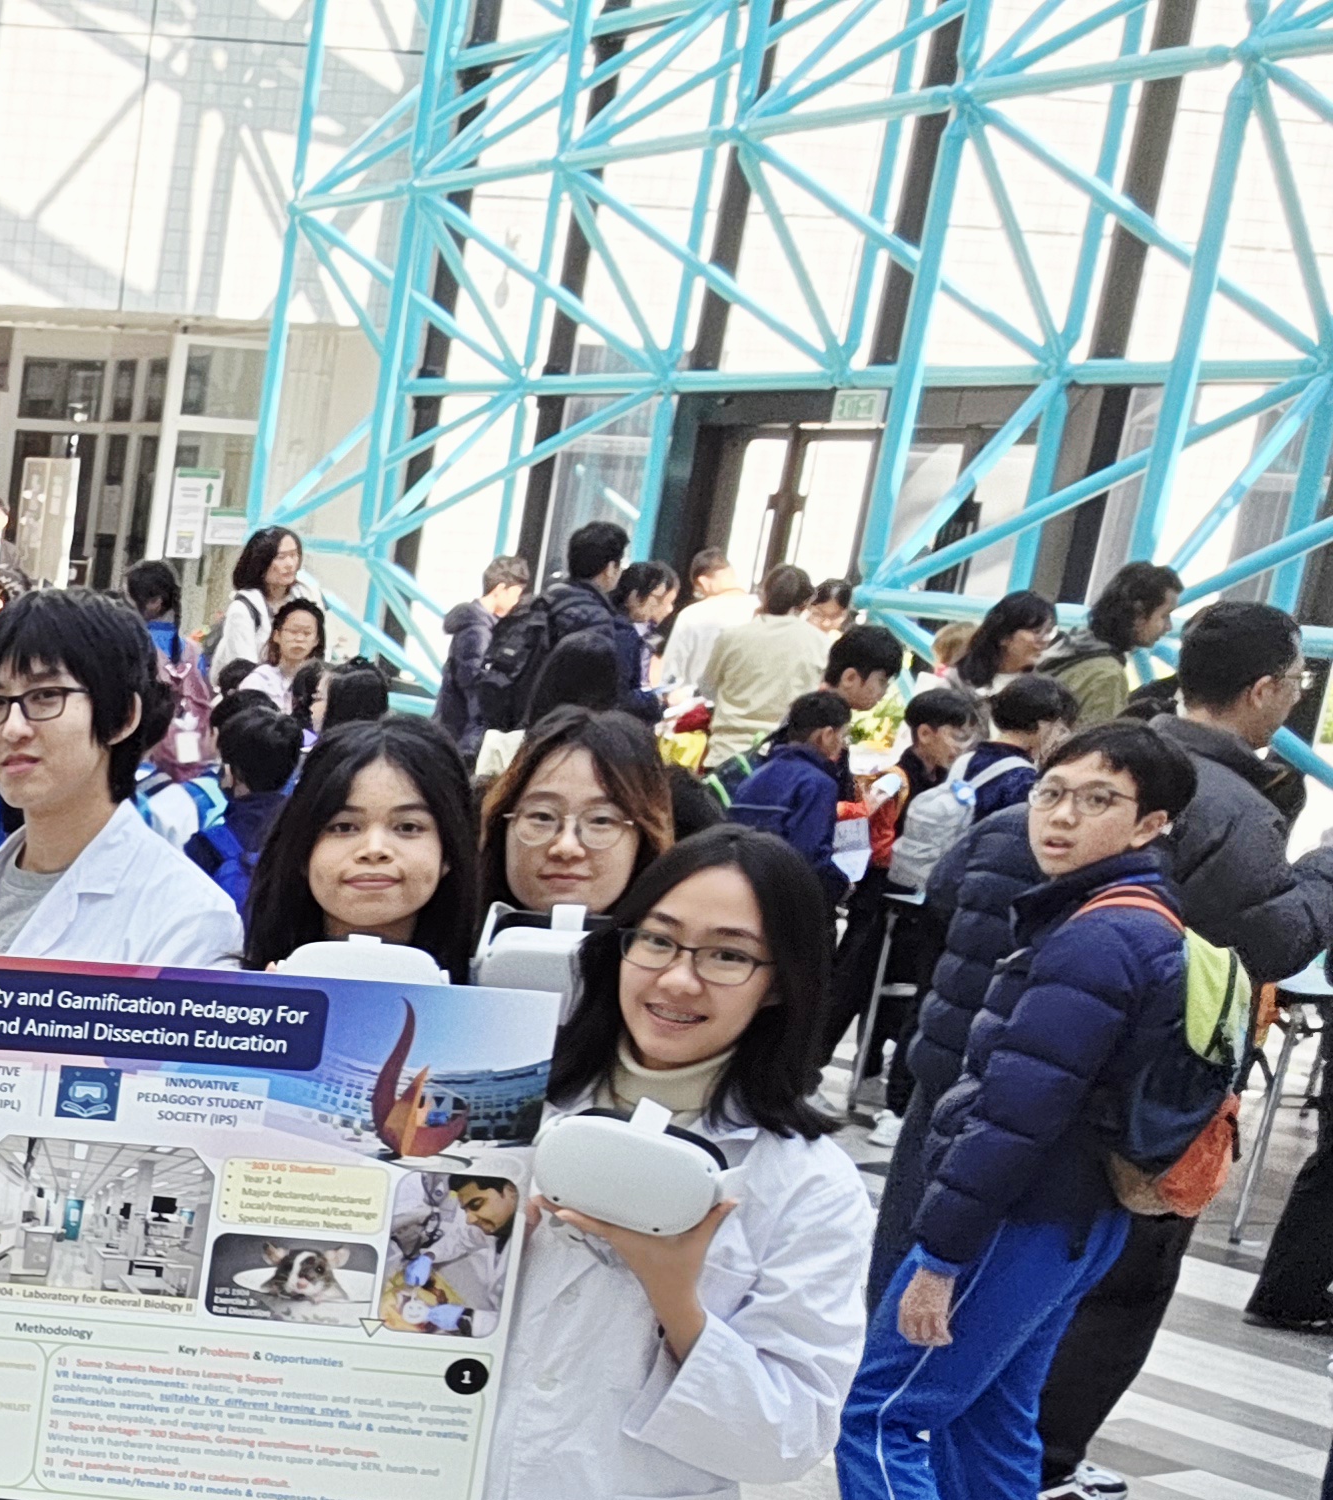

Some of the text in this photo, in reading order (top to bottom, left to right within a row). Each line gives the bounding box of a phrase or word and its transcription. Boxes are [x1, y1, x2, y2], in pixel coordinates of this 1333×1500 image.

[16, 989, 53, 1007] and
[57, 990, 175, 1015] Gamification
[180, 998, 272, 1025] Pedagogy
[275, 1005, 308, 1024] For
[23, 1018, 89, 1039] Animal
[93, 1022, 188, 1046] Dissection
[193, 1029, 287, 1053] Education
[165, 1076, 239, 1092] INNOVATIVE
[137, 1091, 263, 1110] PEDAGOGY STUDENT
[157, 1110, 237, 1127] SOCIETY (IPS)
[243, 1174, 281, 1184] Year 1-4
[241, 1187, 270, 1197] Major
[238, 1213, 272, 1224] Special
[273, 1215, 320, 1228] Education
[22, 1289, 79, 1303] Laboratory
[81, 1293, 96, 1303] for
[99, 1295, 141, 1307] General
[143, 1299, 182, 1312] Biology
[14, 1321, 92, 1340] Methodology
[177, 1344, 343, 1367] Key Problems & Opportunities
[461, 1371, 472, 1384] 1
